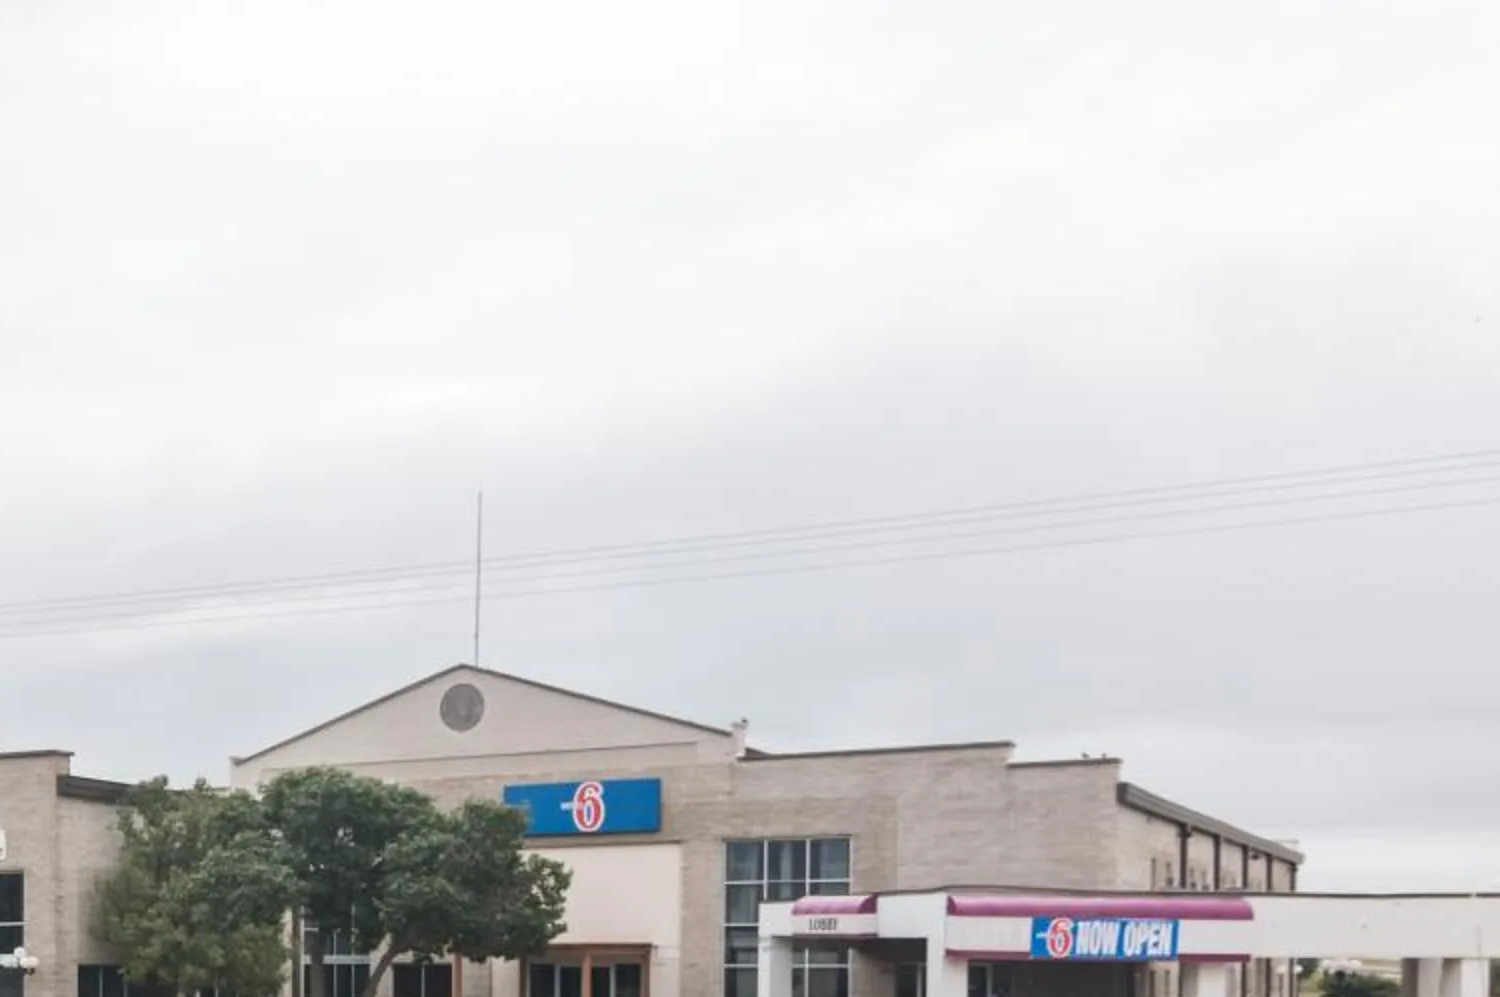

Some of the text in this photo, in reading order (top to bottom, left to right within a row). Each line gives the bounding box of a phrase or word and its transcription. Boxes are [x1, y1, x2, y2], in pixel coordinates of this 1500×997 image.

[573, 781, 605, 832] 6
[1047, 917, 1173, 959] 6 NOW OPEN
